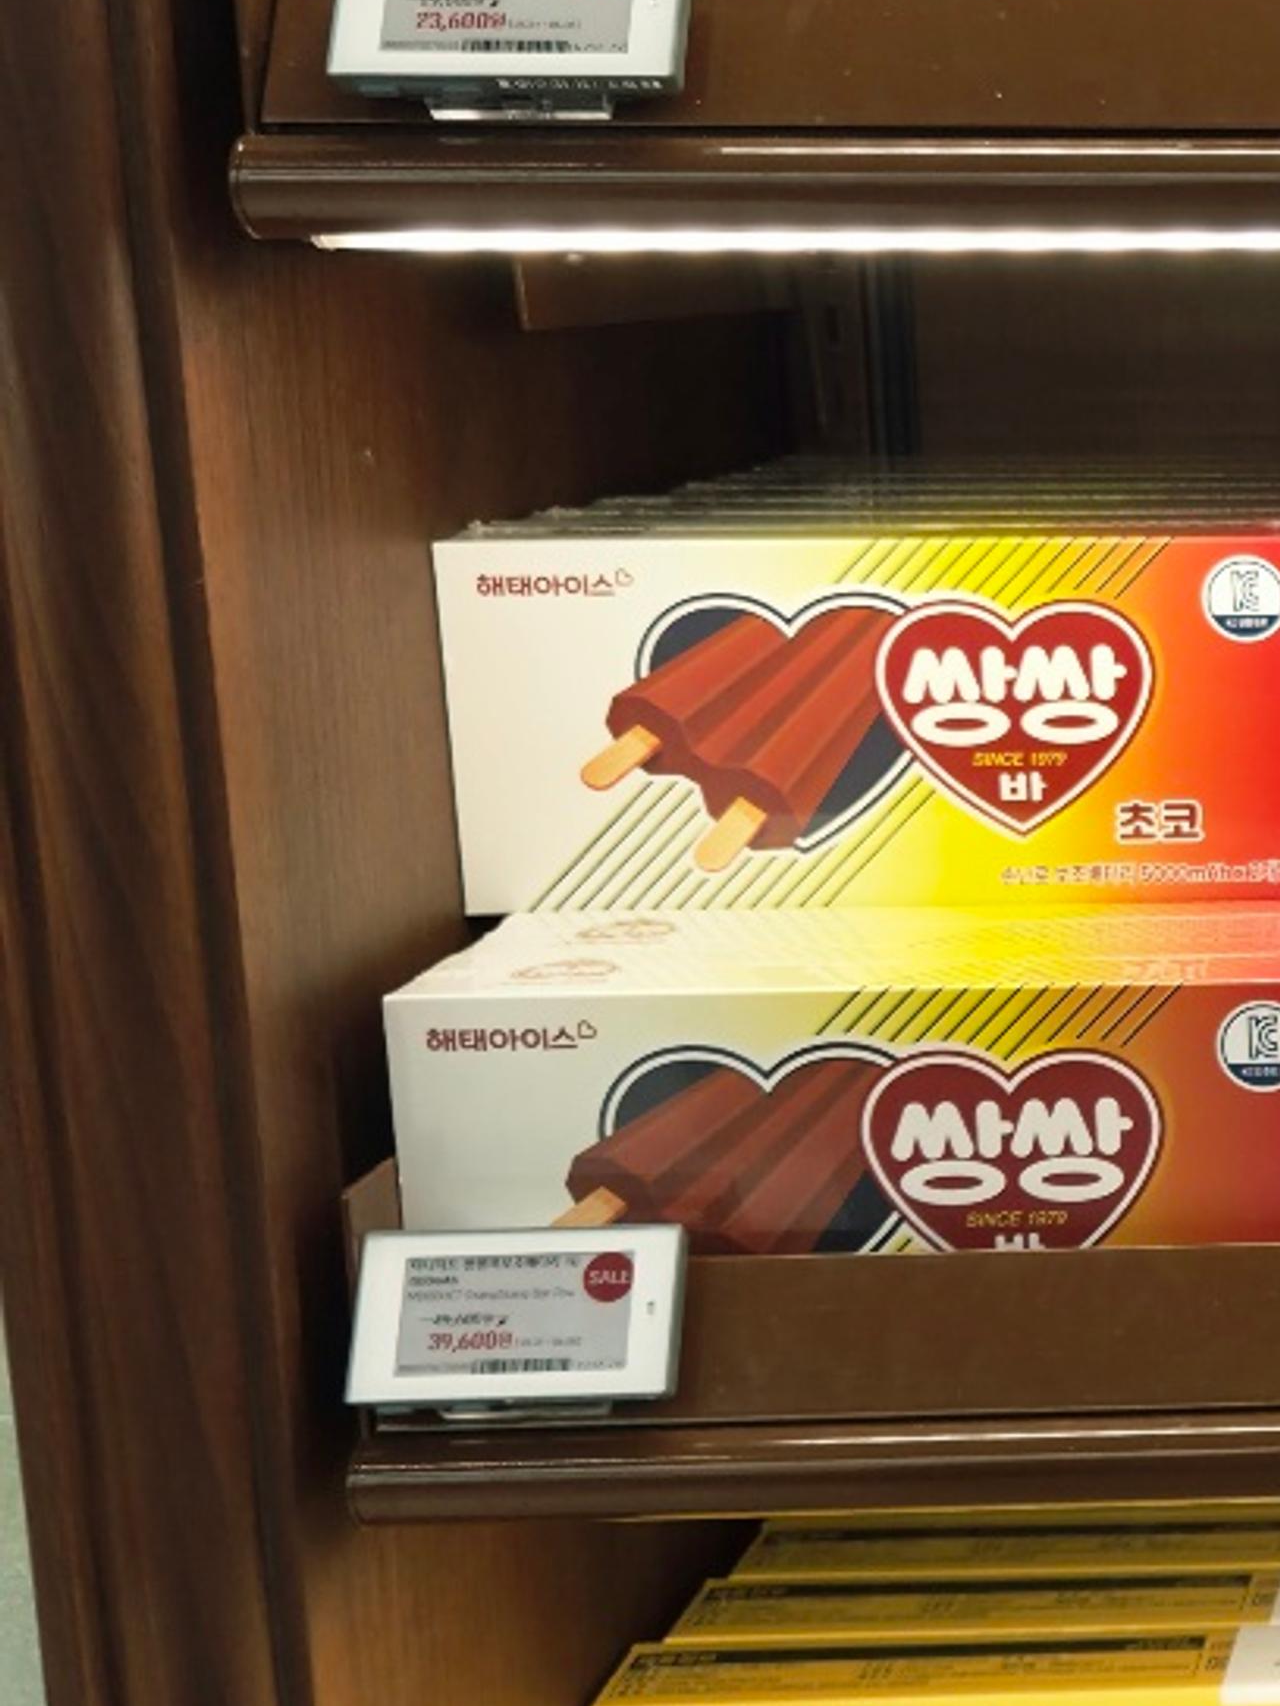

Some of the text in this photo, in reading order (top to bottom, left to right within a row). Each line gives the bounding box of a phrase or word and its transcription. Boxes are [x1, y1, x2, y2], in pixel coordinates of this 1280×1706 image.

[475, 575, 615, 599] 해태아이스
[902, 645, 1129, 746] 쌍쌍
[972, 750, 1068, 768] SINCE 1979
[999, 771, 1047, 802] 바
[1117, 801, 1204, 842] 초코
[426, 1027, 579, 1052] 해태아이스
[889, 1099, 1133, 1204] 쌍쌍
[966, 1209, 1022, 1228] SINCE
[588, 1269, 631, 1285] SALE
